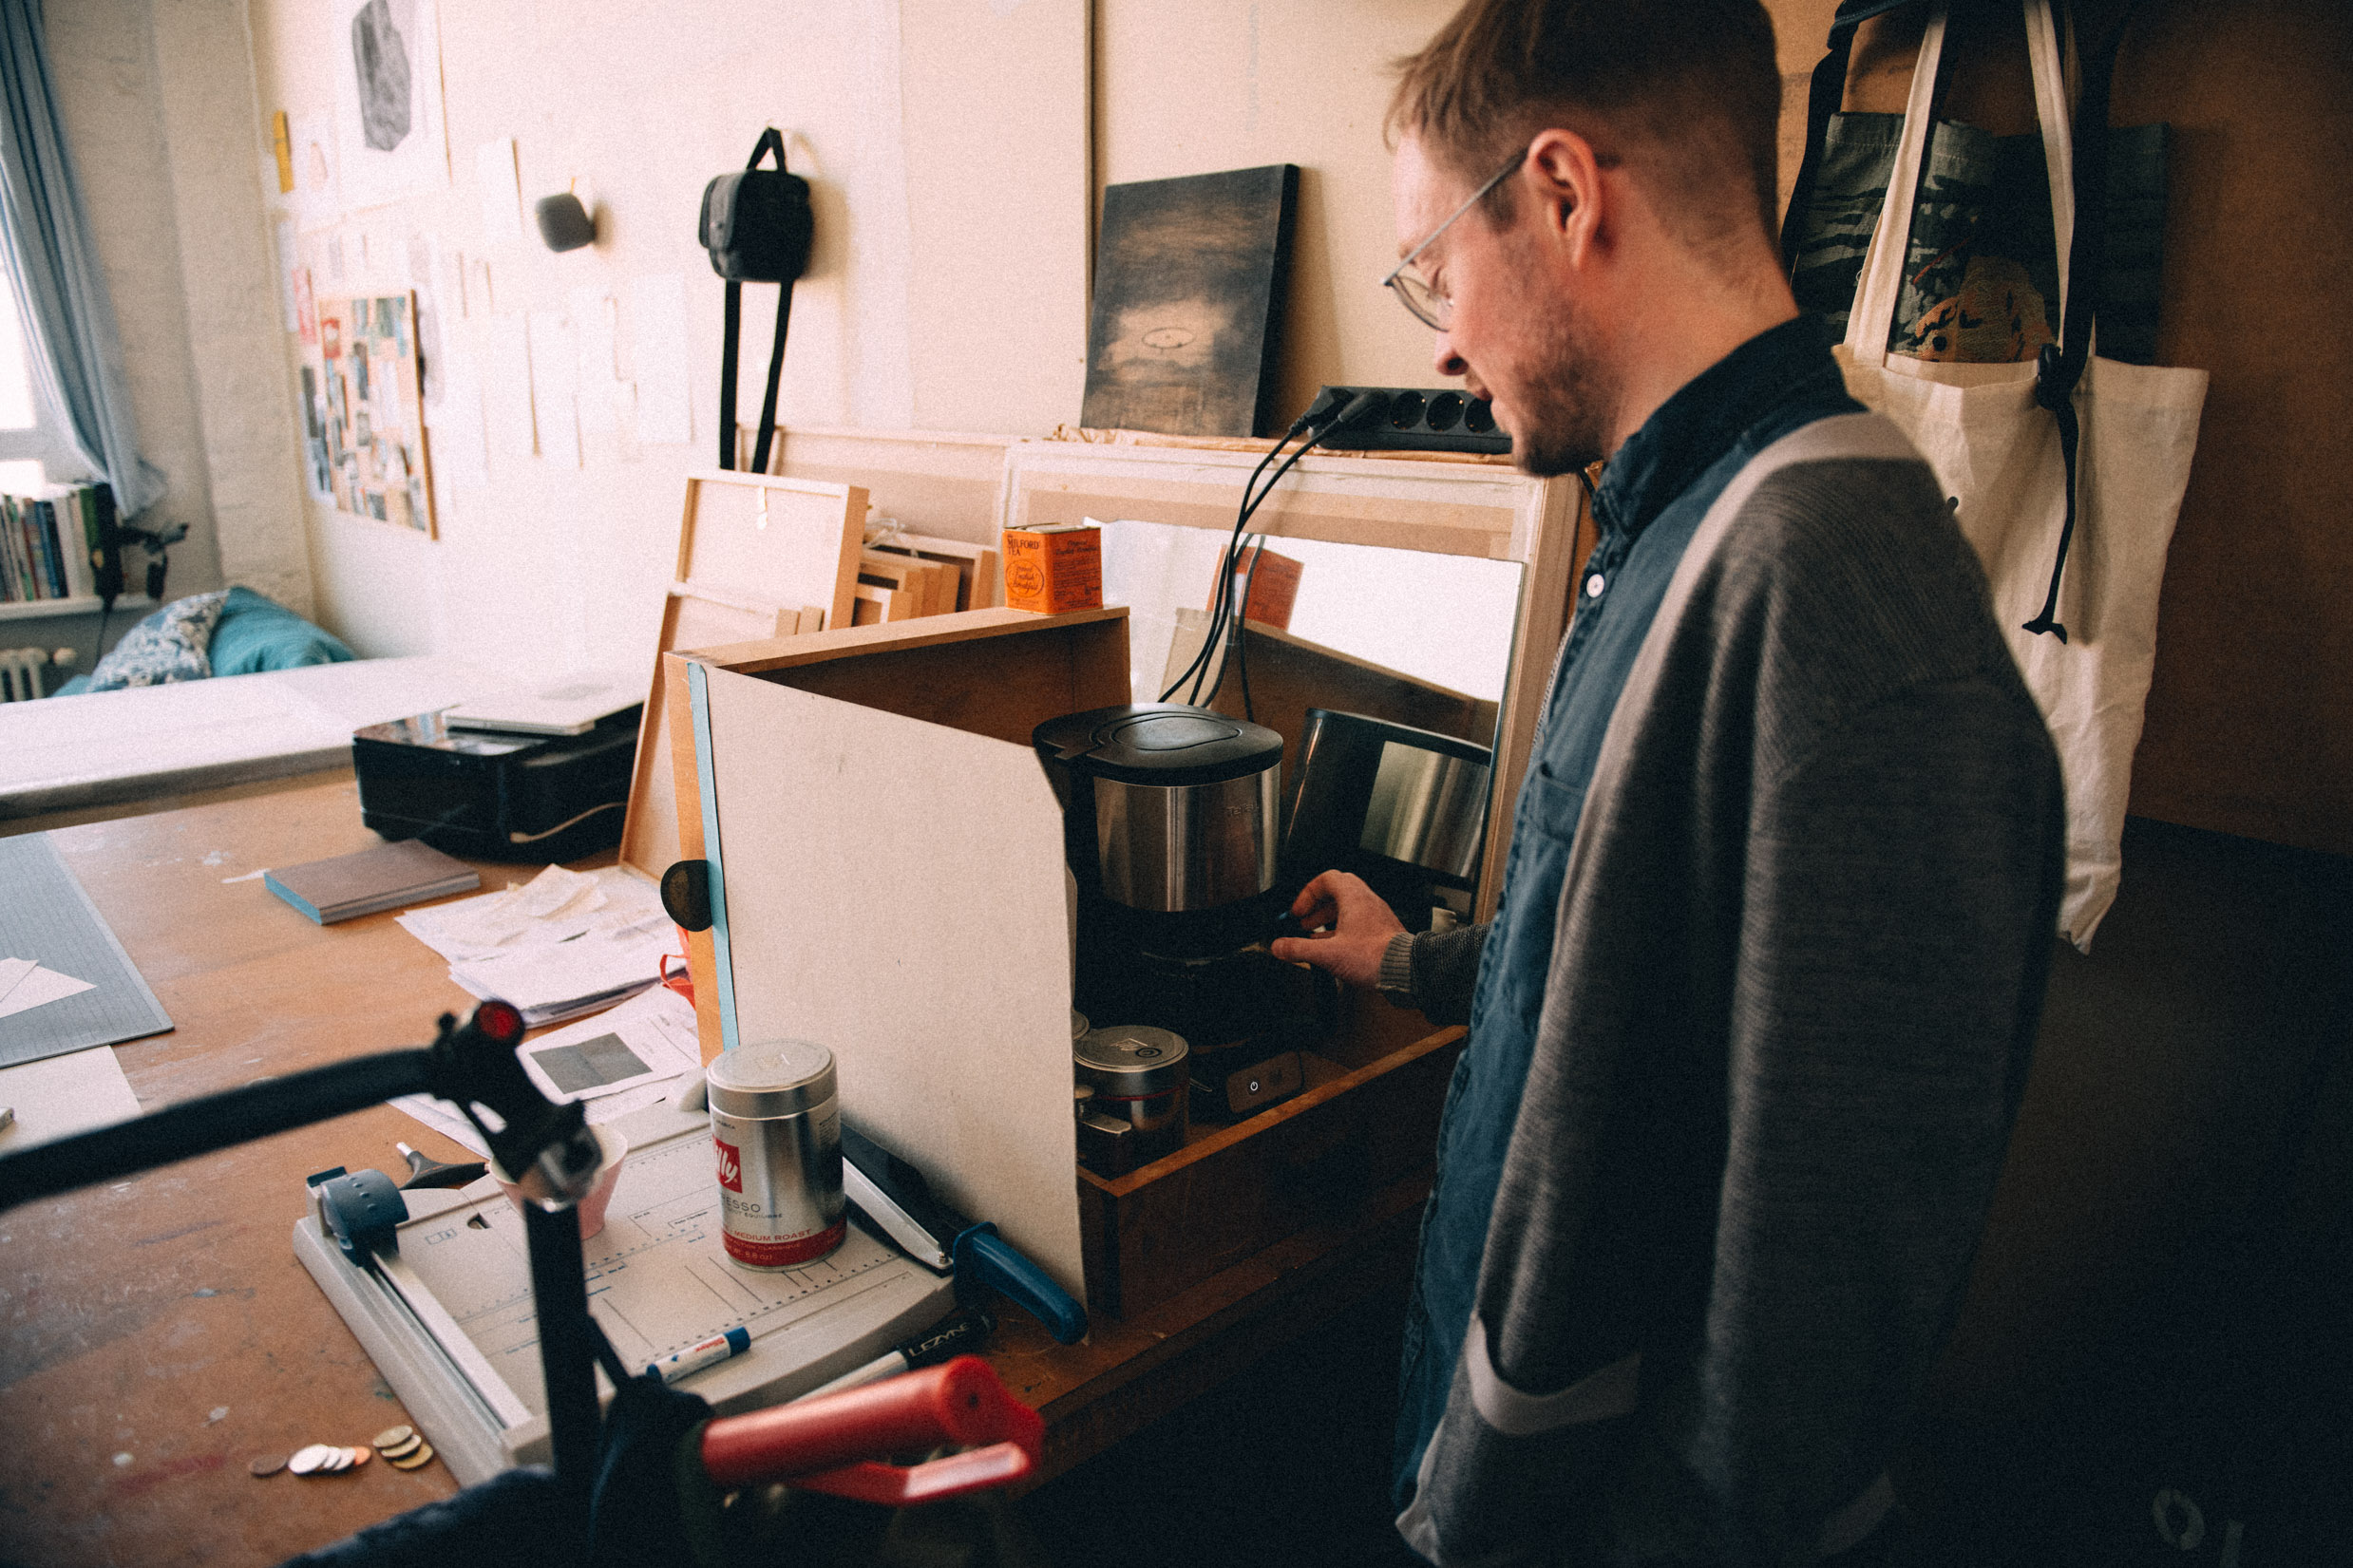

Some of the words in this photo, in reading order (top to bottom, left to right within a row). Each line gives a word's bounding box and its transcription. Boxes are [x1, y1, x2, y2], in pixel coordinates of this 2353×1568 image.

[1007, 538, 1039, 549] MILFORD
[1008, 547, 1021, 556] TEA
[734, 1231, 771, 1241] MEDIUM
[774, 1228, 811, 1241] ROAST
[908, 1321, 970, 1357] LEZYNE
